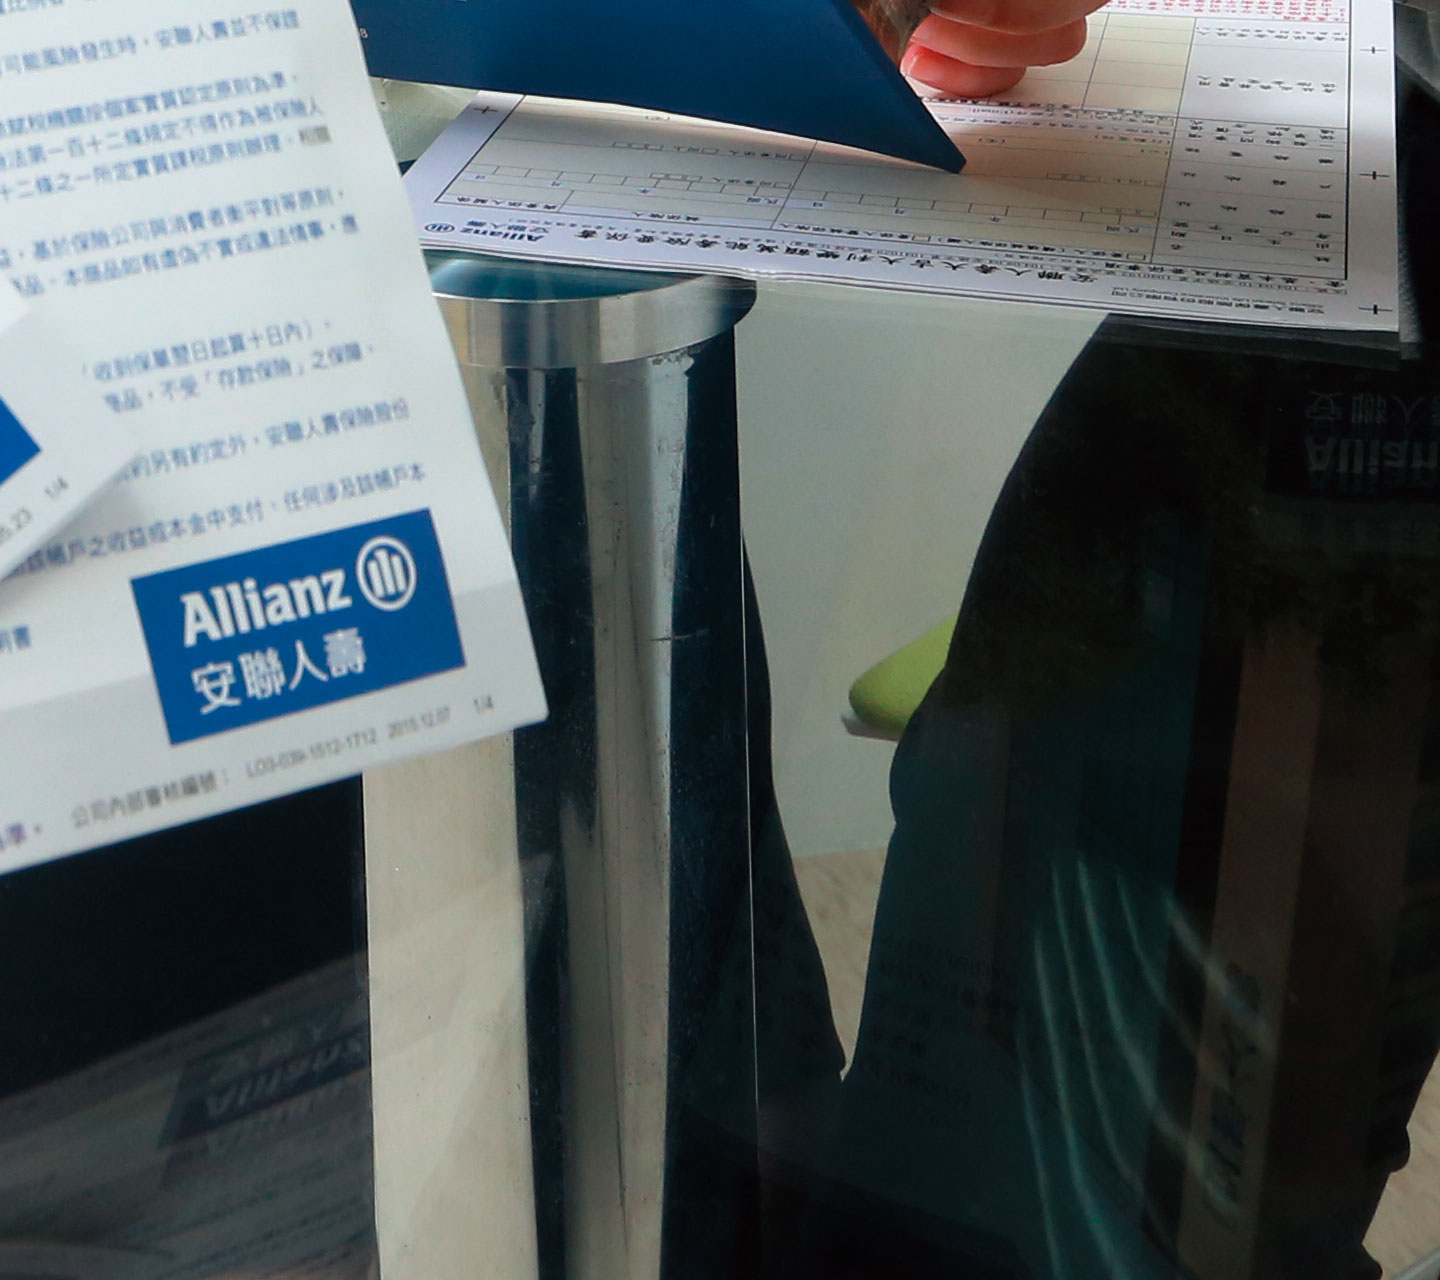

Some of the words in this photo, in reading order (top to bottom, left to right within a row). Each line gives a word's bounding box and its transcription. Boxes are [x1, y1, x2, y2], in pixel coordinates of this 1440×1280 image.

[458, 226, 545, 242] Allianz
[179, 567, 354, 649] Allianz
[192, 625, 368, 717] 安聯人壽
